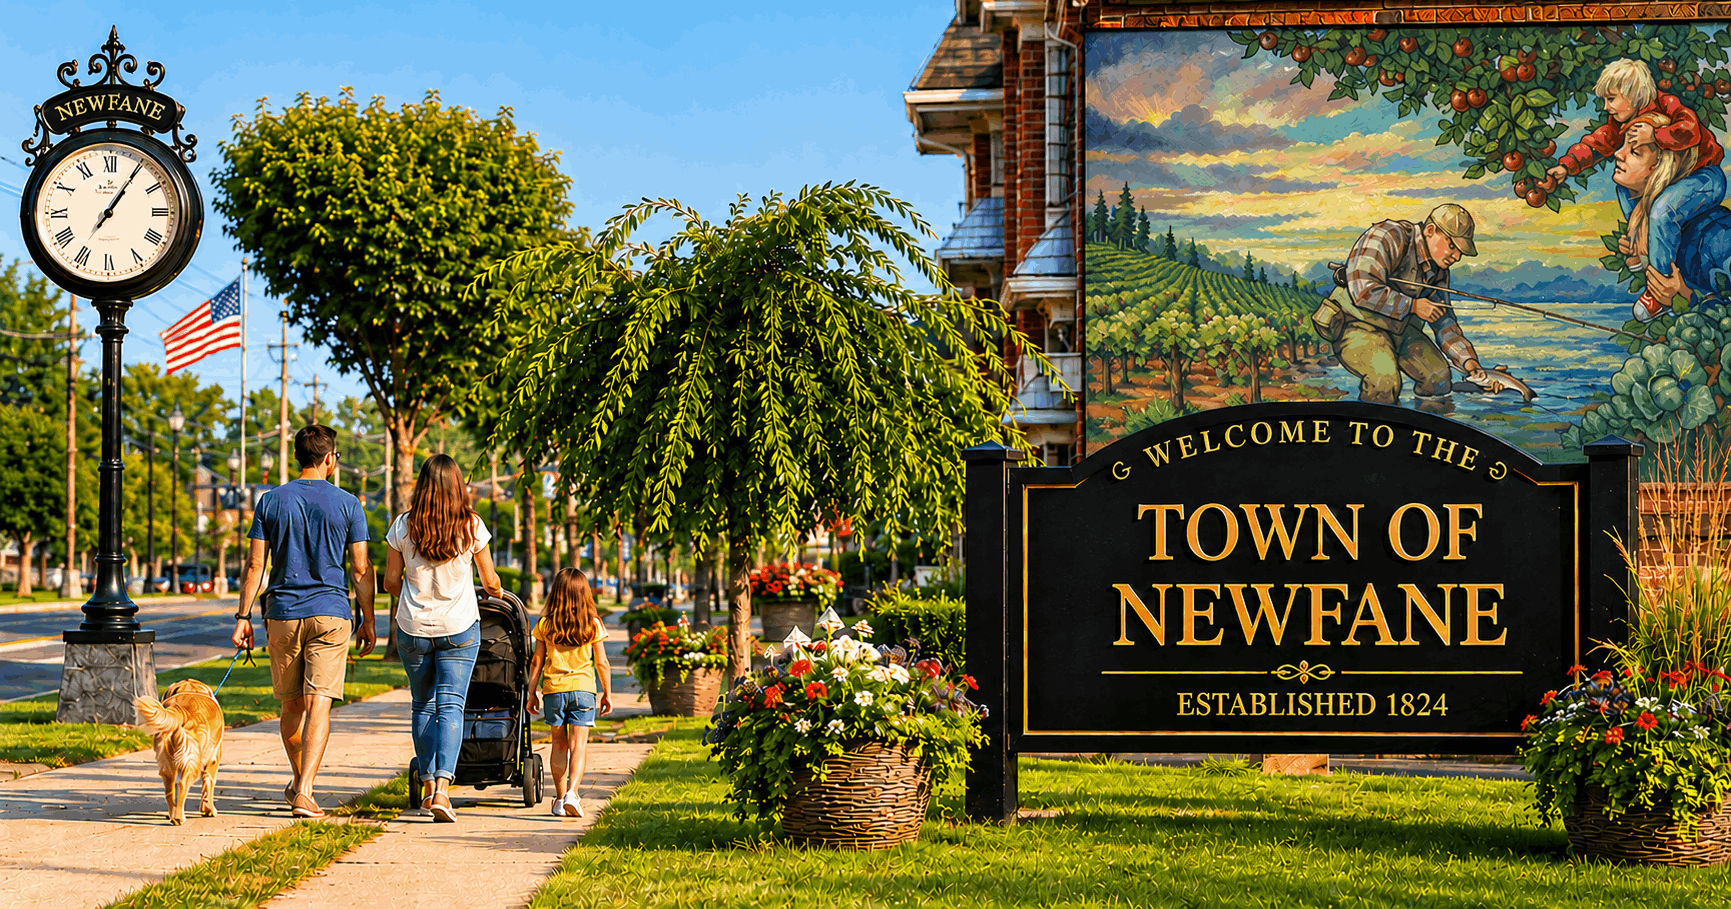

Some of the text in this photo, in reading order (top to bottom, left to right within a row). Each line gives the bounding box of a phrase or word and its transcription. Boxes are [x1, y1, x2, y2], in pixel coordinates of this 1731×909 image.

[54, 93, 166, 121] NEWFANE
[76, 161, 93, 180] XI
[103, 155, 118, 173] XII
[57, 182, 76, 197] X
[145, 182, 162, 195] II
[151, 207, 169, 217] III
[1142, 420, 1480, 471] WELCOME TO THE
[1137, 503, 1484, 561] TOWN OF
[1111, 583, 1508, 647] NEWFANE
[1177, 692, 1449, 717] ESTABLISHED 1824
